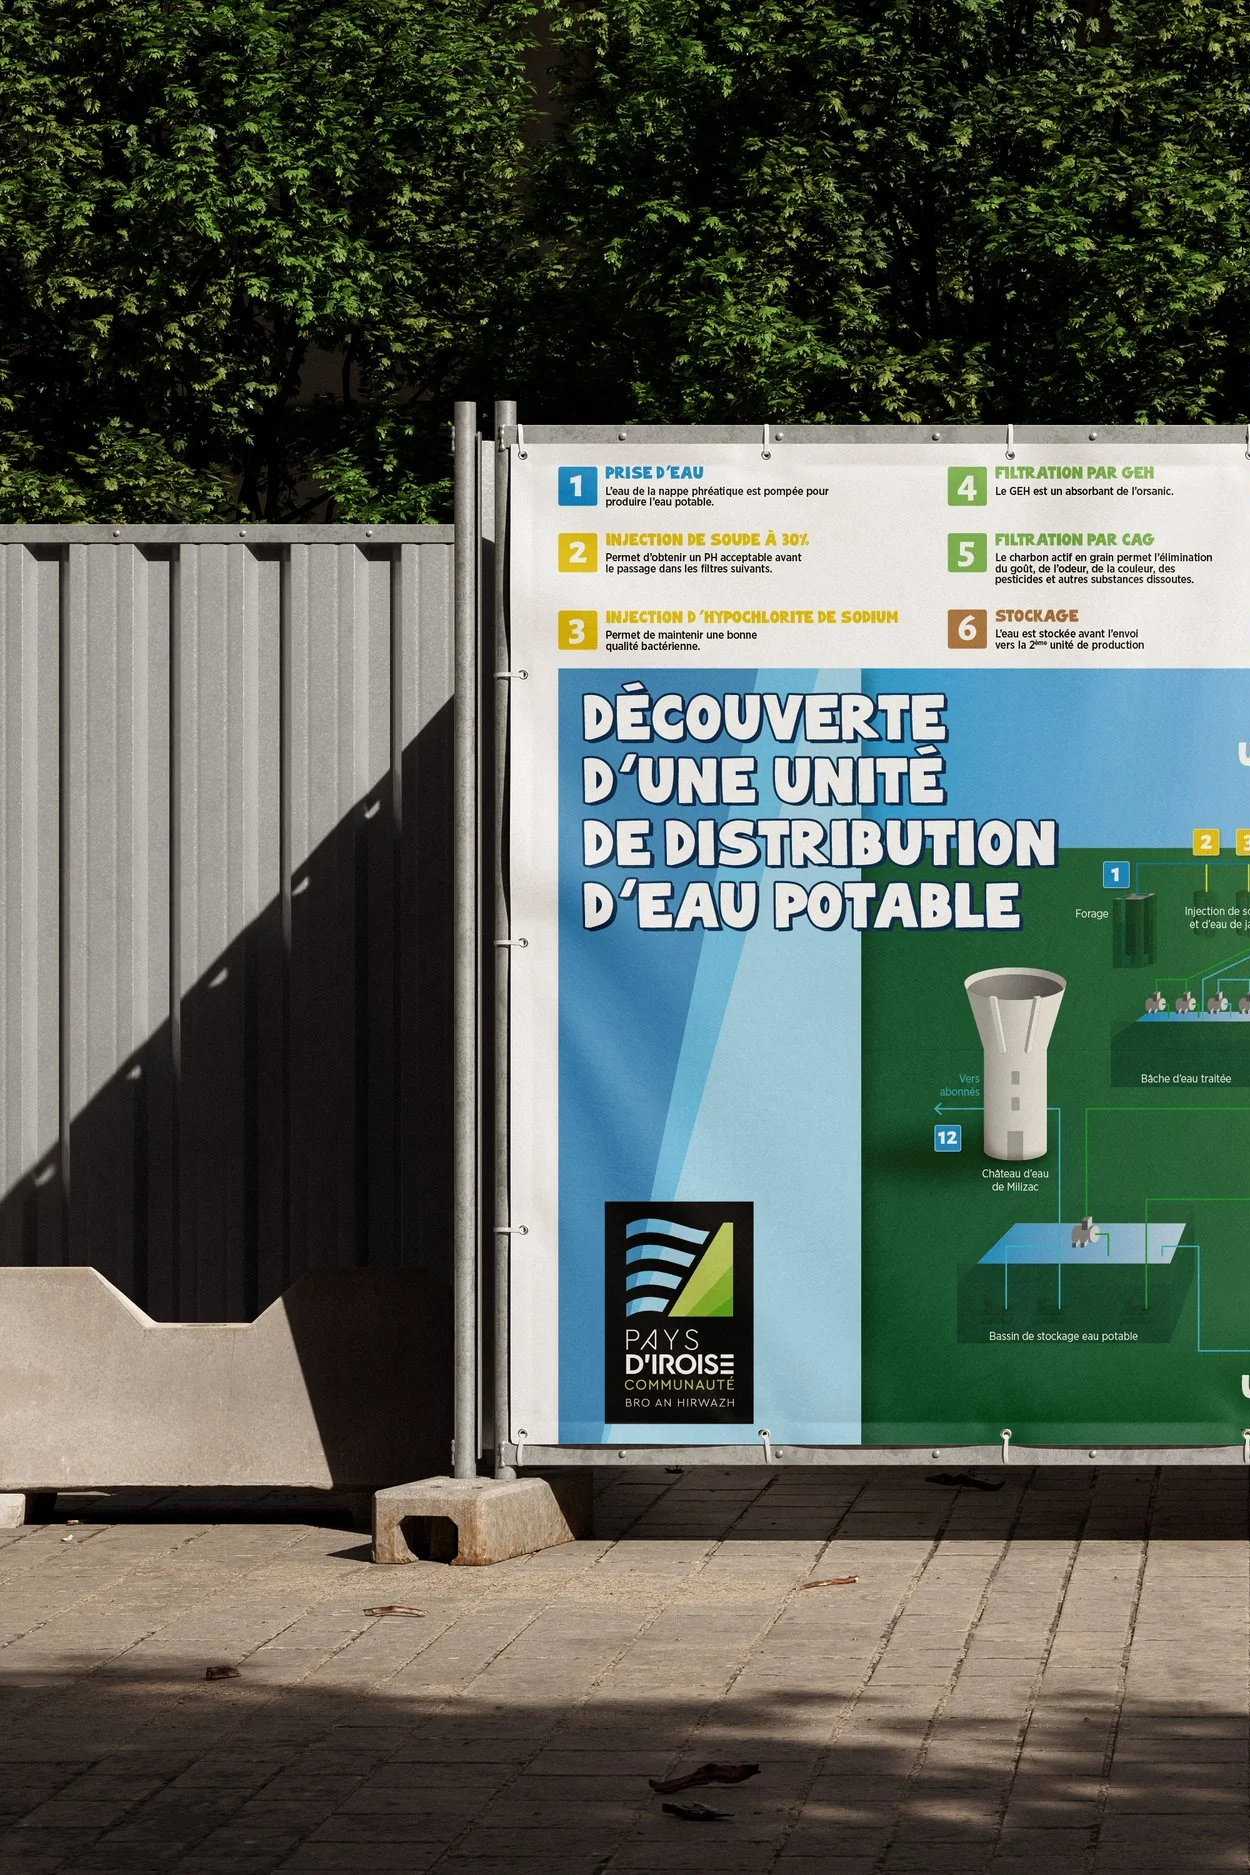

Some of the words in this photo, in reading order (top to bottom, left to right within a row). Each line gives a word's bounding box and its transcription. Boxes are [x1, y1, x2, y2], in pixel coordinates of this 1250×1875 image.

[605, 465, 653, 480] PRISE
[655, 464, 704, 480] D'EAU
[994, 465, 1084, 480] FILTRATION
[1086, 465, 1119, 480] PAR
[1121, 465, 1155, 480] GEH
[569, 475, 582, 496] 1
[605, 486, 630, 496] L'eau
[632, 486, 645, 496] de
[647, 486, 656, 496] la
[658, 488, 689, 498] nappe
[691, 486, 744, 499] phréatique
[746, 486, 762, 496] est
[763, 485, 804, 498] pompée
[806, 488, 830, 498] pour
[957, 475, 978, 501] 4
[995, 486, 1007, 496] Le
[1009, 486, 1031, 496] GEH
[1033, 486, 1048, 496] est
[1050, 488, 1063, 496] un
[1064, 486, 1114, 496] absorbant
[1116, 486, 1129, 496] de
[1131, 486, 1174, 496] l'orsanic.
[605, 496, 647, 509] produire
[649, 495, 673, 507] l'eau
[674, 496, 715, 509] potable.
[604, 532, 684, 547] INJECTION
[686, 532, 707, 547] DE
[710, 532, 762, 547] SOUDE
[781, 532, 810, 547] 30%
[994, 532, 1084, 547] FILTRATION
[1086, 532, 1118, 547] PAR
[1121, 532, 1155, 547] CAG
[568, 542, 588, 563] 2
[957, 542, 975, 567] 5
[605, 609, 684, 625] INJECTION
[817, 609, 837, 625] DE
[840, 609, 900, 625] SODIUM
[995, 608, 1080, 623] STOCKAGE
[568, 619, 586, 644] 3
[605, 629, 641, 640] Permet
[643, 630, 656, 640] de
[658, 630, 704, 640] maintenir
[706, 631, 725, 640] une
[726, 629, 758, 640] bonne
[957, 615, 977, 640] 6
[605, 640, 639, 653] qualité
[641, 641, 701, 651] bactérienne.
[582, 681, 949, 744] DÉCOUVERTE
[582, 753, 759, 806] D'UNE
[773, 745, 947, 806] UNITÉ
[582, 819, 654, 868] DE
[665, 819, 1059, 869] DISTRIBUTION
[1200, 834, 1213, 850] 2
[1110, 867, 1120, 882] 1
[582, 878, 760, 932] D'EAU
[773, 881, 1023, 932] POTABLE
[1075, 908, 1109, 921] Forage
[1141, 1073, 1171, 1084] Bâche
[1172, 1073, 1199, 1084] d'eau
[1200, 1073, 1232, 1084] traitée
[937, 1130, 958, 1145] 12
[981, 1168, 1021, 1179] Château
[1023, 1168, 1049, 1179] d'eau
[991, 1181, 1005, 1192] de
[1006, 1181, 1039, 1192] Milizac
[625, 1329, 699, 1350] PAYS
[989, 1331, 1020, 1341] Bassin
[1021, 1331, 1035, 1341] de
[1036, 1330, 1080, 1343] stockage
[1081, 1333, 1099, 1341] eau
[1101, 1331, 1139, 1343] potable
[625, 1354, 735, 1375] D'IROISE
[624, 1375, 735, 1391] COMMUNAUTÉ
[625, 1397, 651, 1408] BRO
[654, 1398, 672, 1408] AN
[677, 1397, 735, 1408] HIRWAZH
